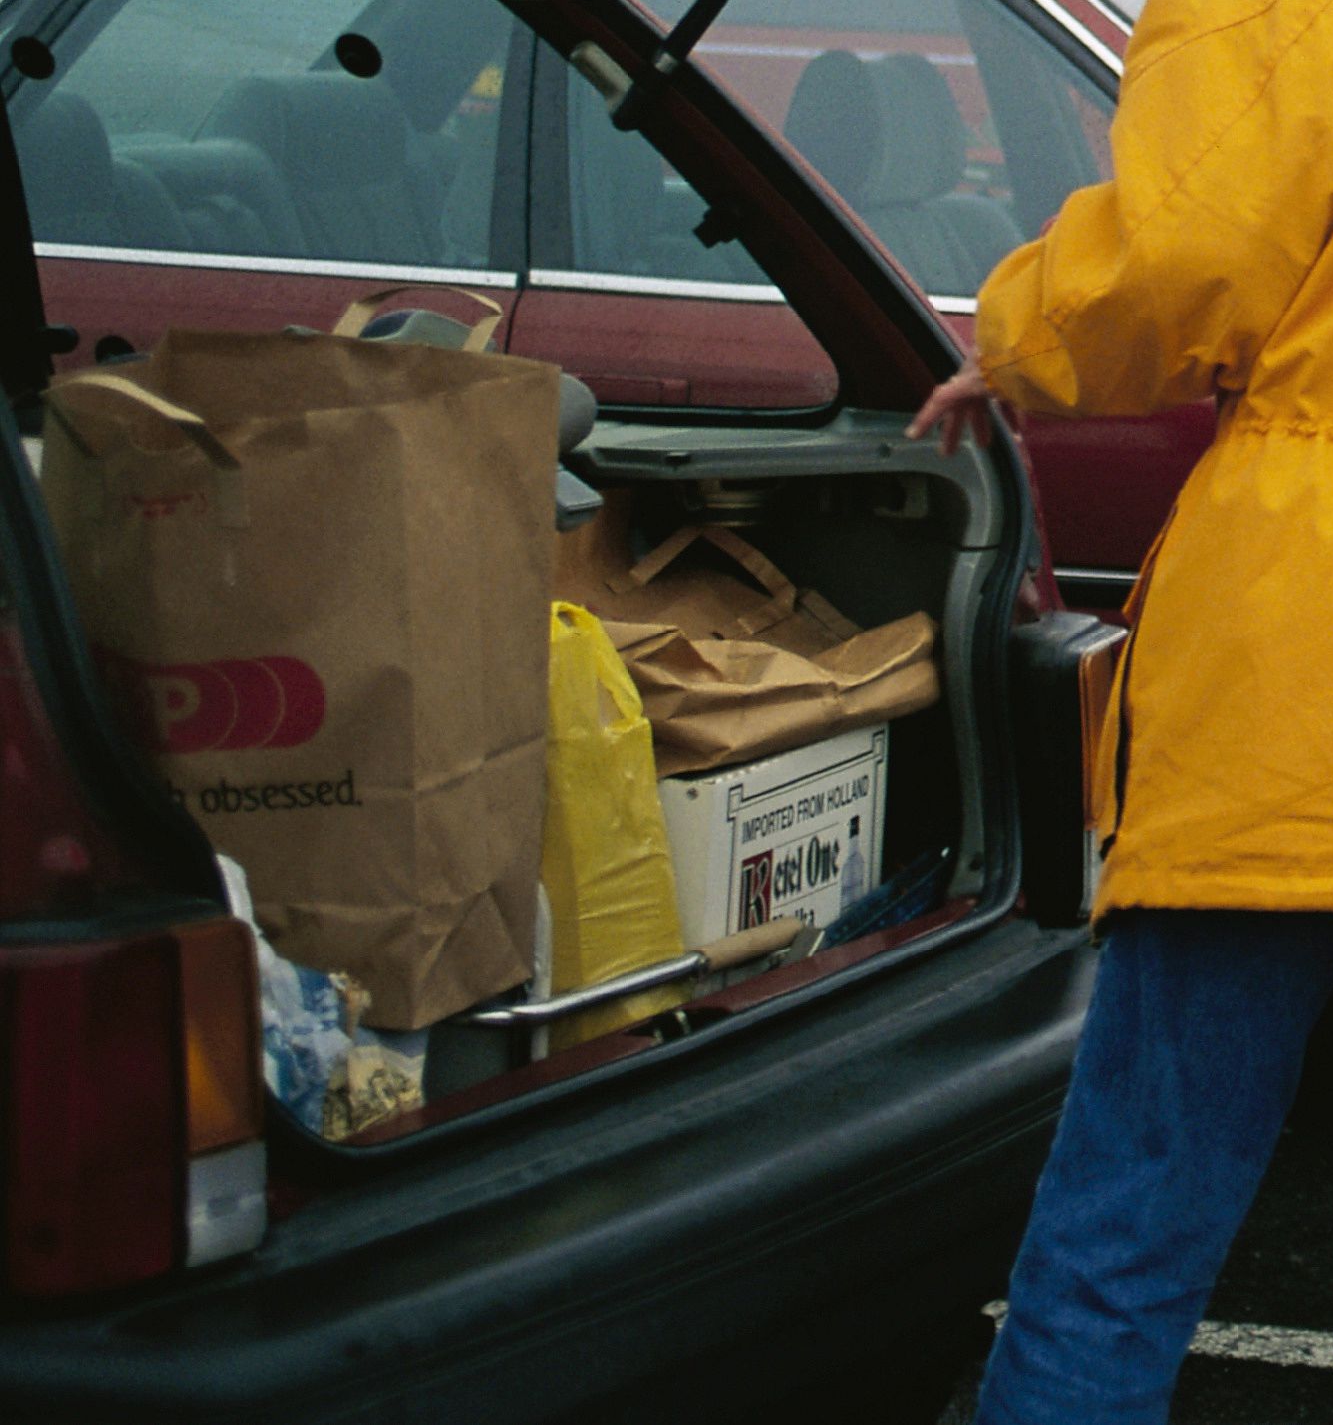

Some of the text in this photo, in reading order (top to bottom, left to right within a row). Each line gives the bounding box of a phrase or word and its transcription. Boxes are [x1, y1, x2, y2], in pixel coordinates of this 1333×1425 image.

[201, 770, 363, 814] obsessed.
[742, 775, 869, 844] IMPORTED FROM HOLLAND
[739, 836, 840, 931] Ketel One
